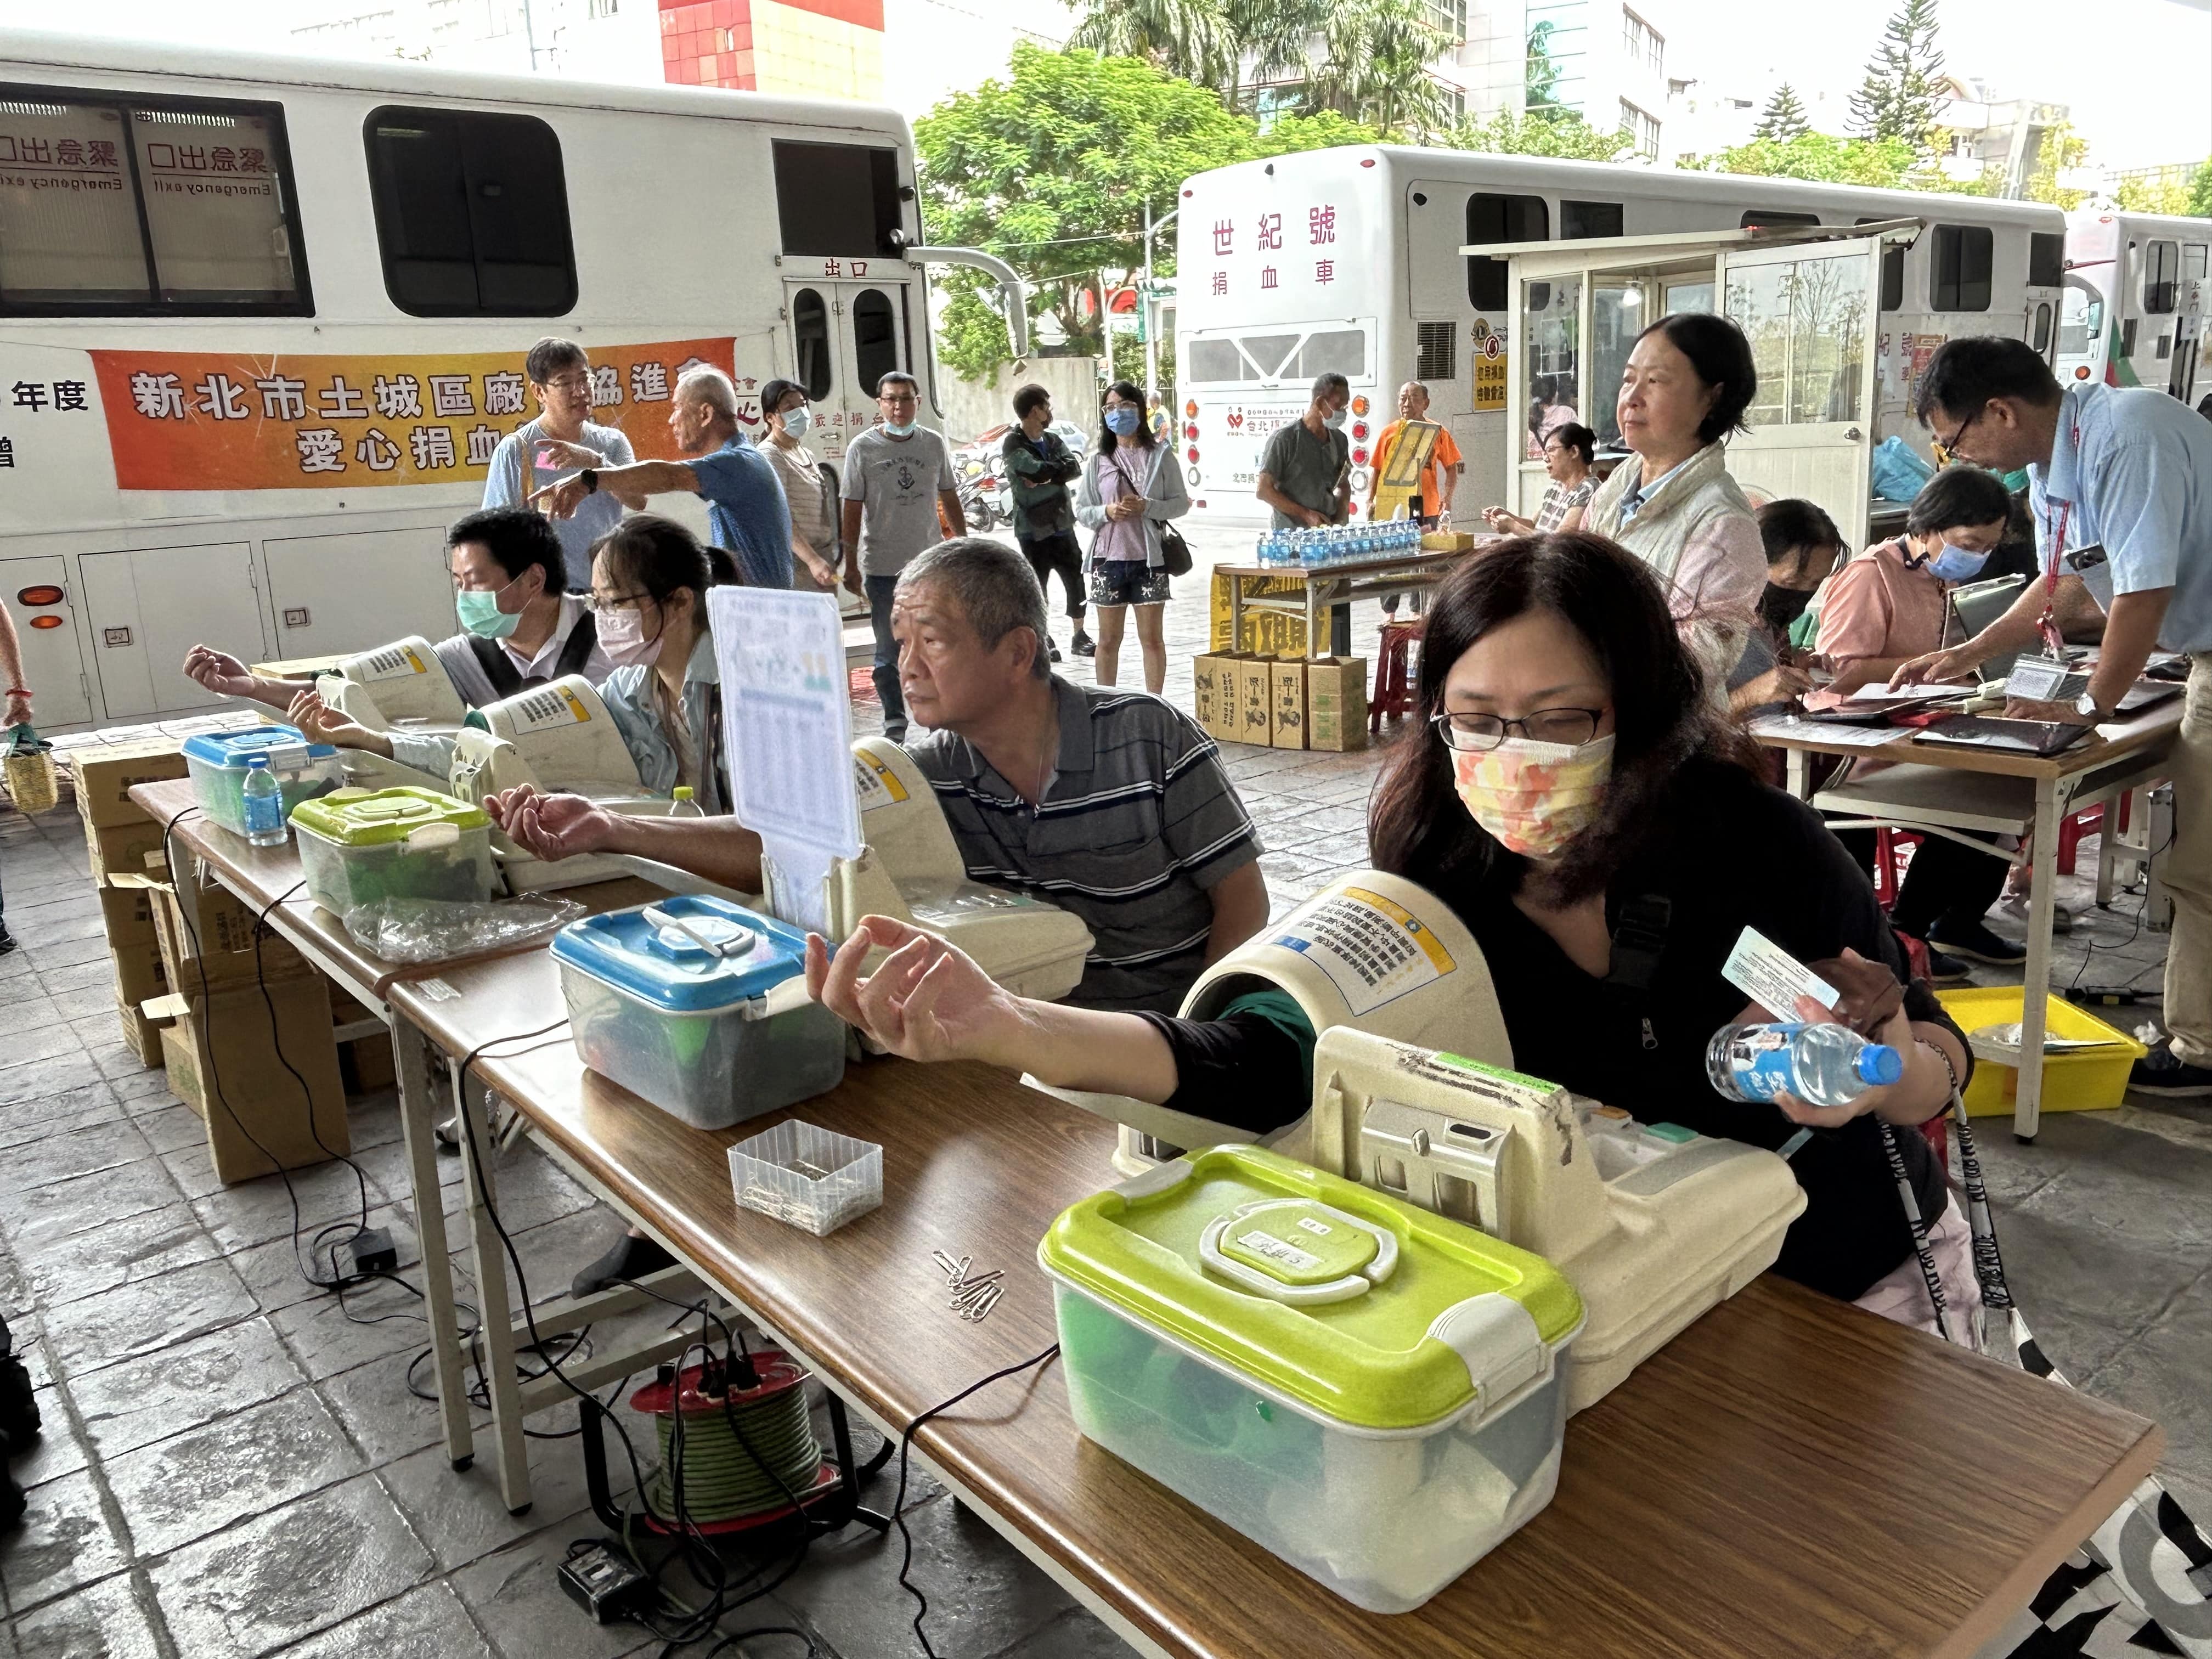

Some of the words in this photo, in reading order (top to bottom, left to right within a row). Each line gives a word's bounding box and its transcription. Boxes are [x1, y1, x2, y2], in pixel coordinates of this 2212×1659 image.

[1212, 204, 1335, 256] 世紀號
[825, 257, 868, 278] 出口
[1212, 259, 1335, 296] 捐血車
[130, 357, 713, 421] 新北市土城區廠協進
